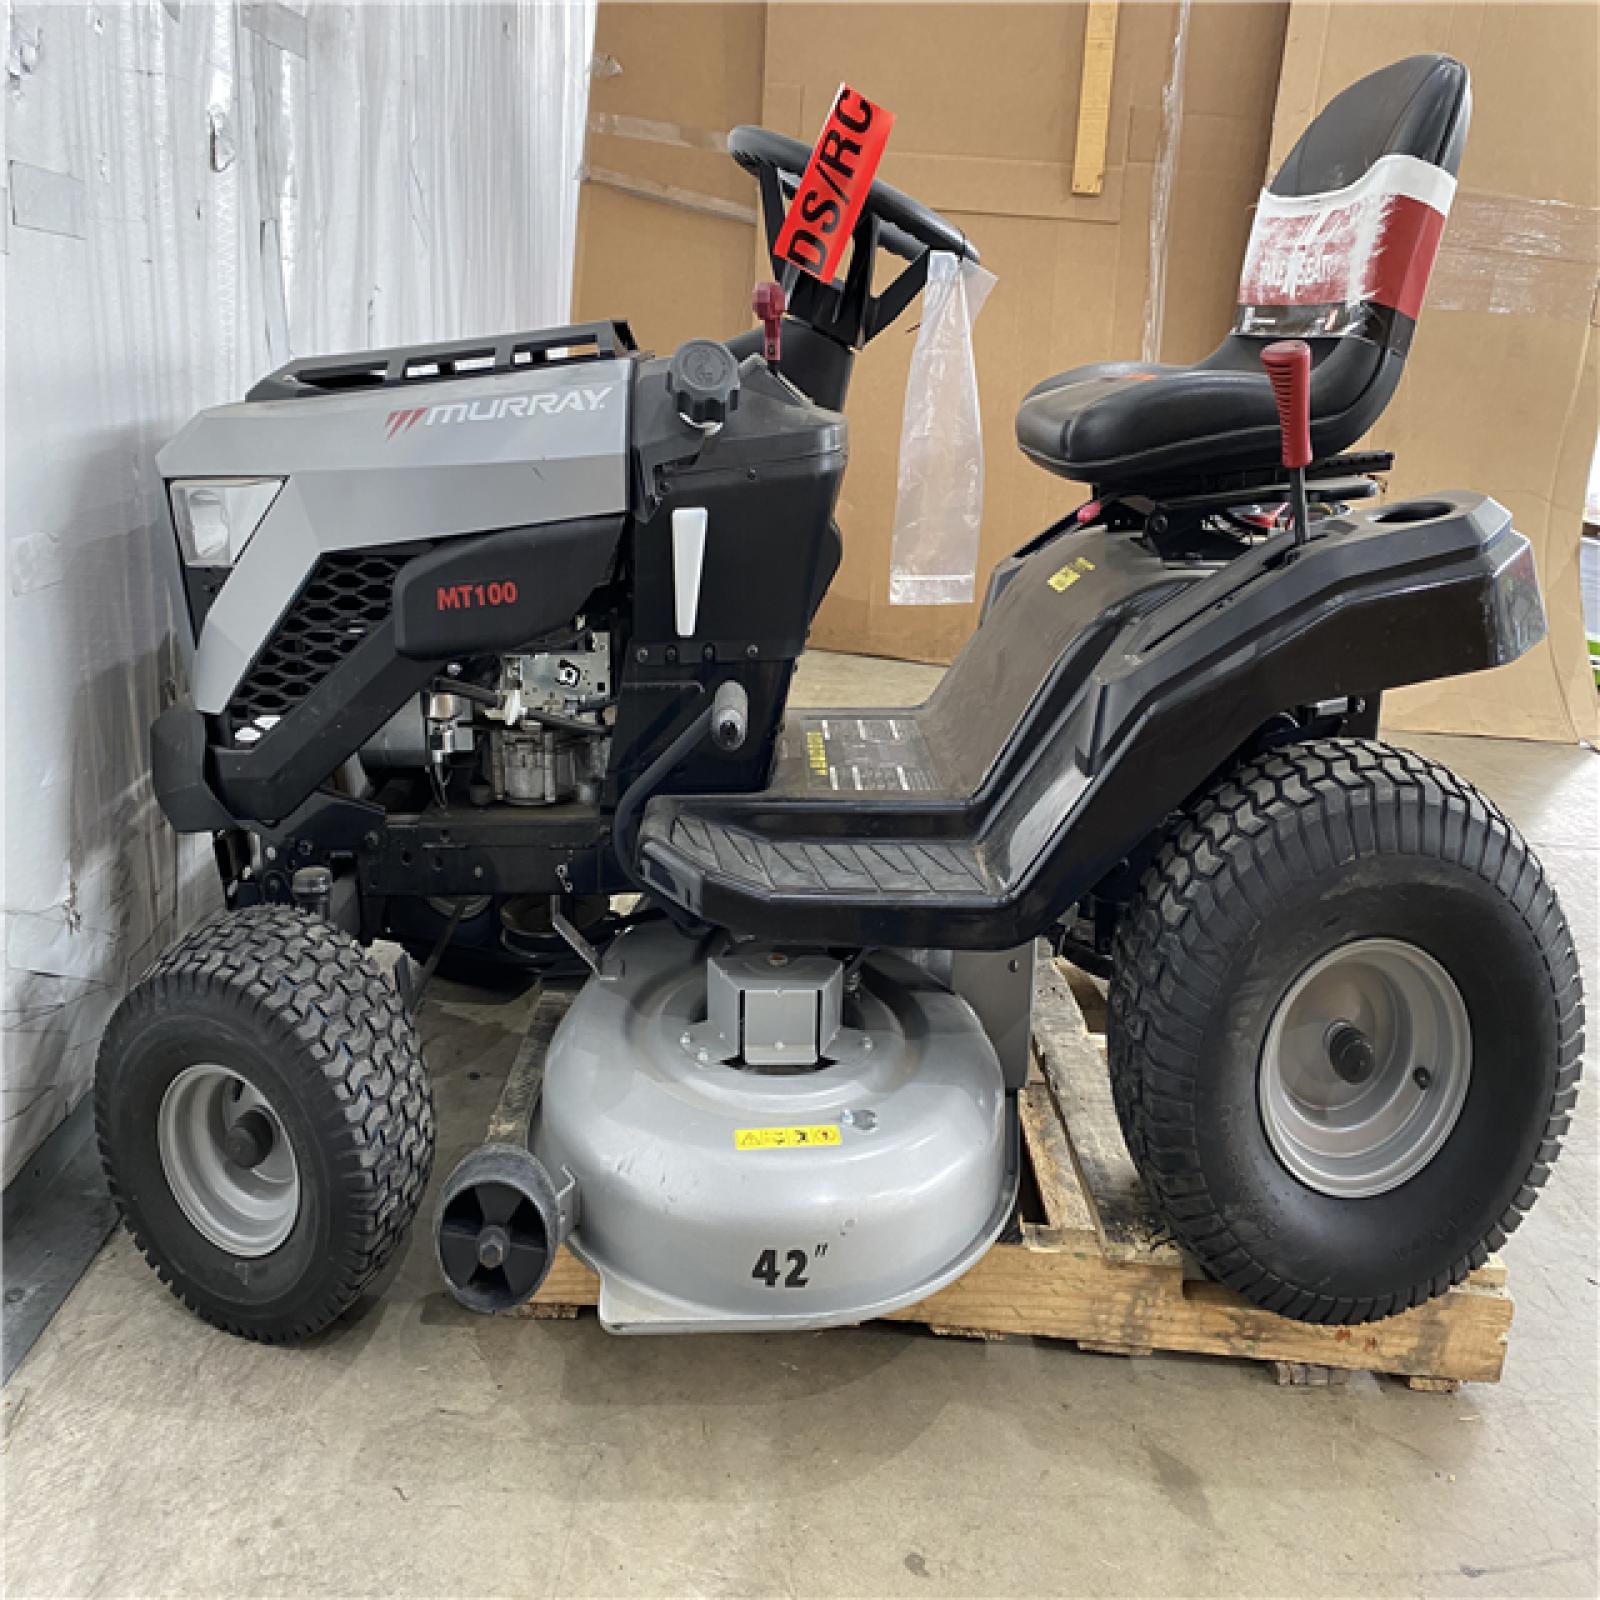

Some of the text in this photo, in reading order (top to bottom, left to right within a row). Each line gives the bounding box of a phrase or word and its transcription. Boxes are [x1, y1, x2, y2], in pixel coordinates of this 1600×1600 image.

[787, 89, 872, 275] DS/RC
[425, 387, 612, 426] MURRAY
[437, 581, 518, 611] MT100
